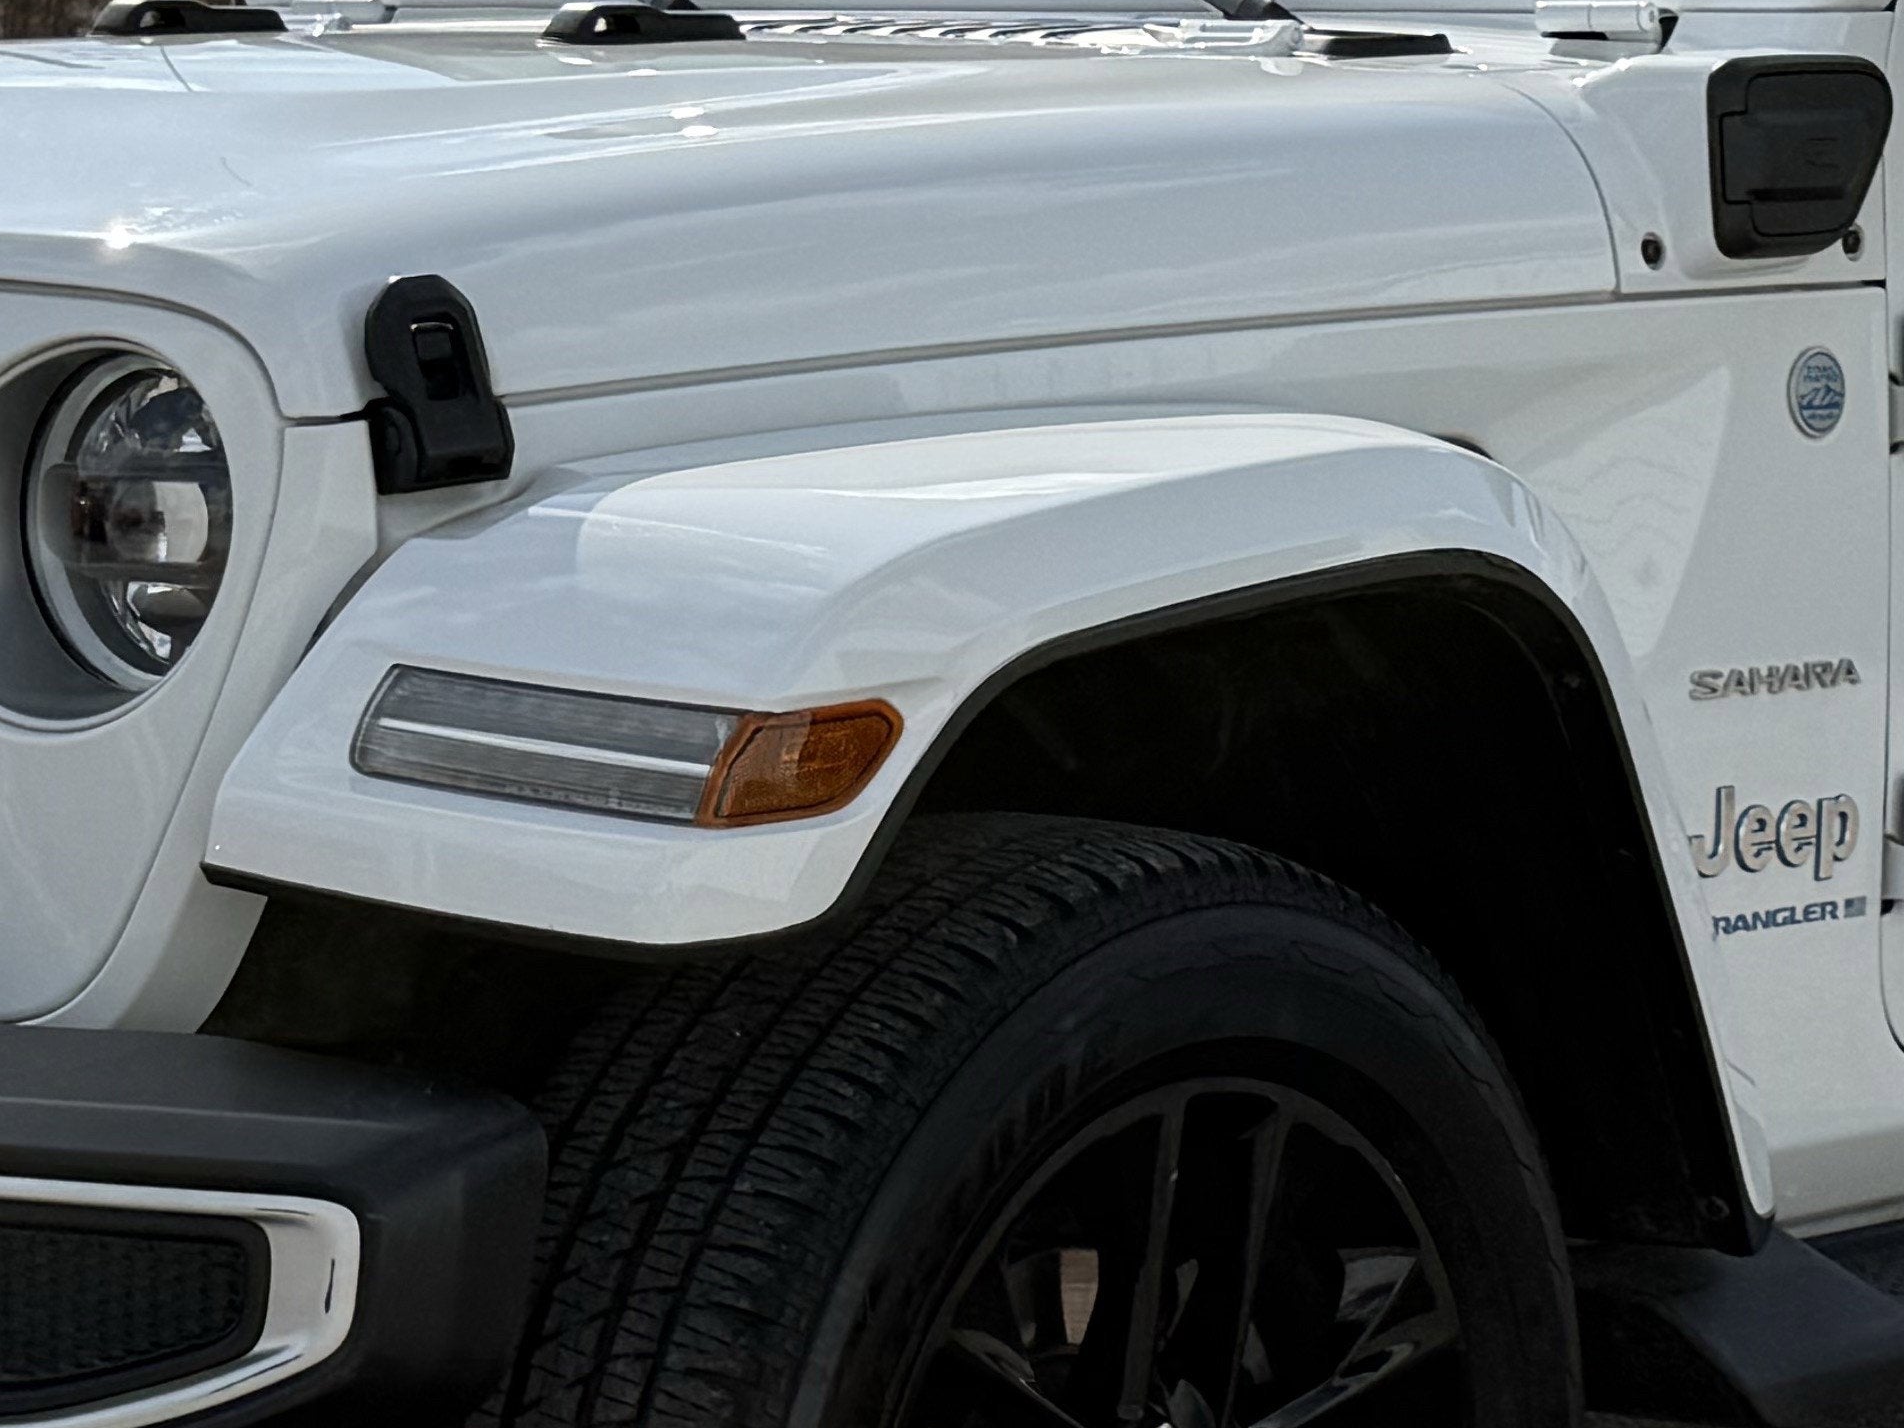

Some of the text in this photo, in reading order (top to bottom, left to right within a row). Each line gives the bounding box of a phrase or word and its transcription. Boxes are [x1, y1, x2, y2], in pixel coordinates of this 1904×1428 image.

[1689, 658, 1861, 701] SAHARA
[1688, 785, 1860, 881] Jeep
[1711, 900, 1839, 936] RANGLER
